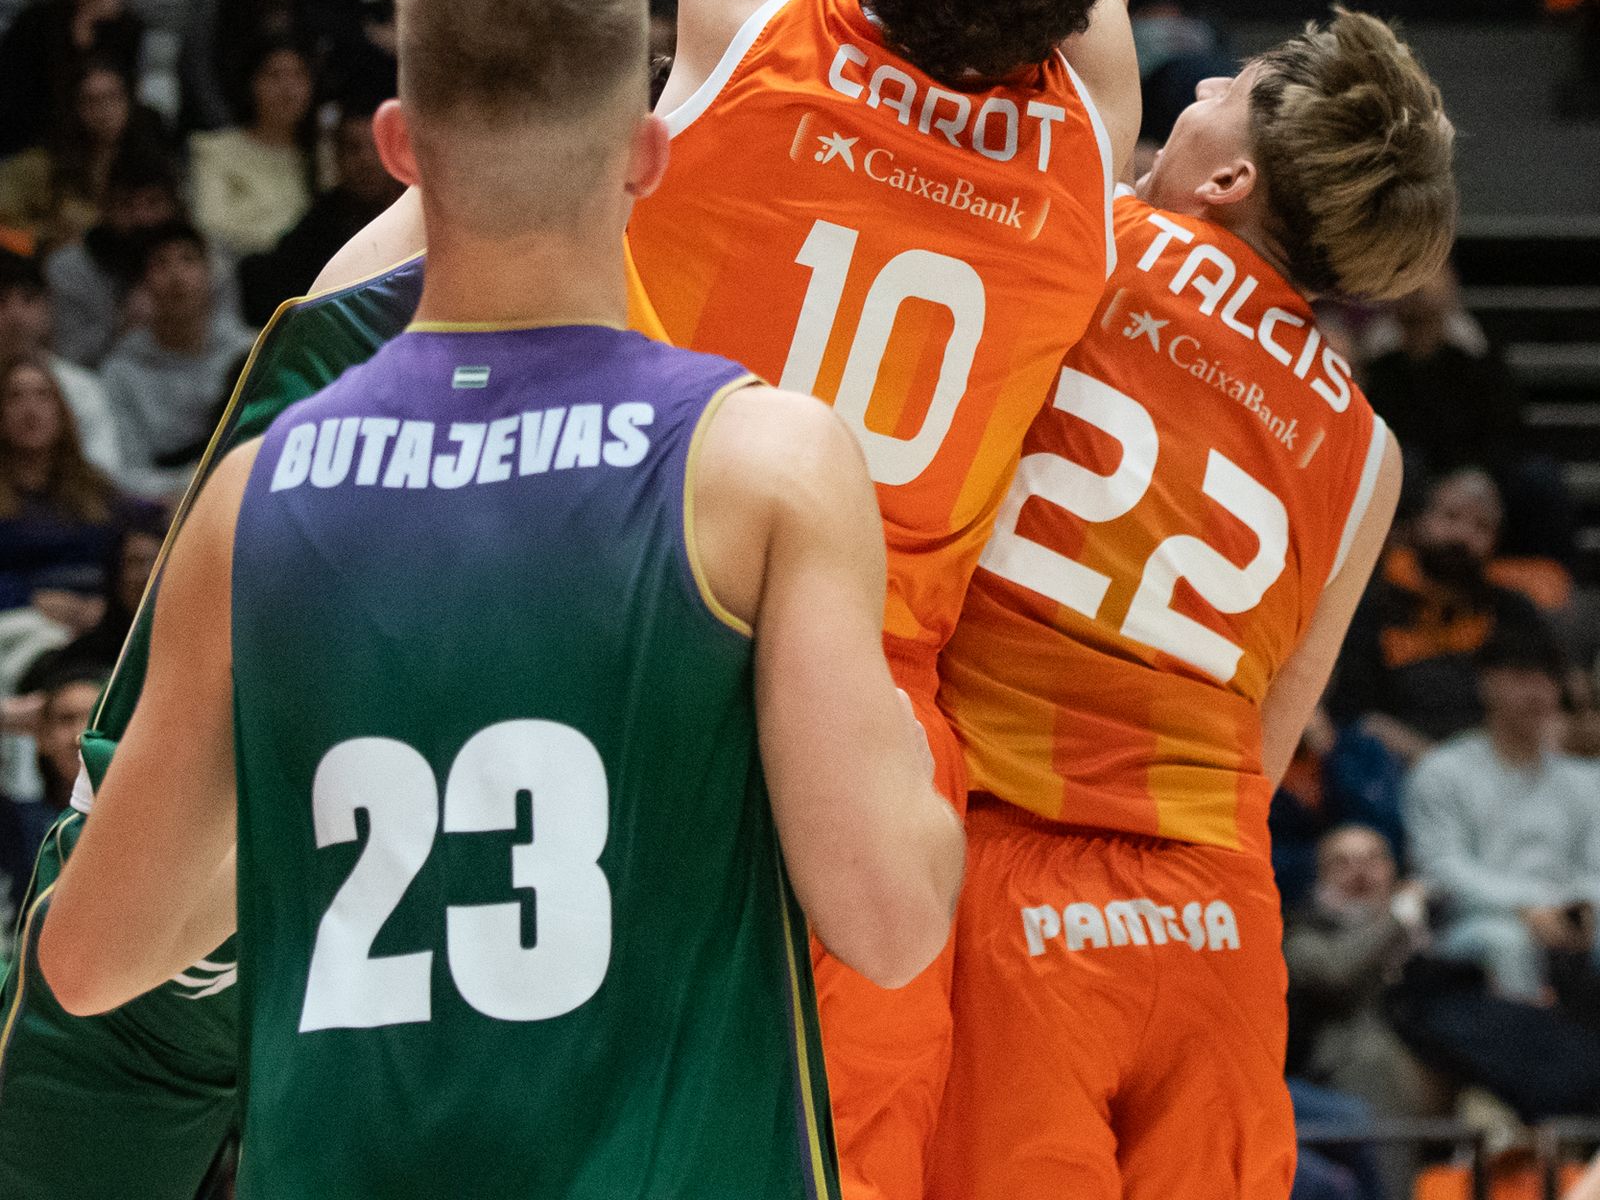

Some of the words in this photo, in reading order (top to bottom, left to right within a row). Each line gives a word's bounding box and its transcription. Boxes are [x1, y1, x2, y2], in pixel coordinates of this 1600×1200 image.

[828, 43, 1066, 173] CAROT
[863, 148, 1026, 229] CaixaBank
[778, 218, 986, 486] 10
[1136, 212, 1352, 413] TALCIS
[1168, 334, 1298, 450] CaixaBank
[270, 402, 655, 493] BUTAJEVAS
[978, 365, 1290, 683] 22
[298, 717, 612, 1033] 23
